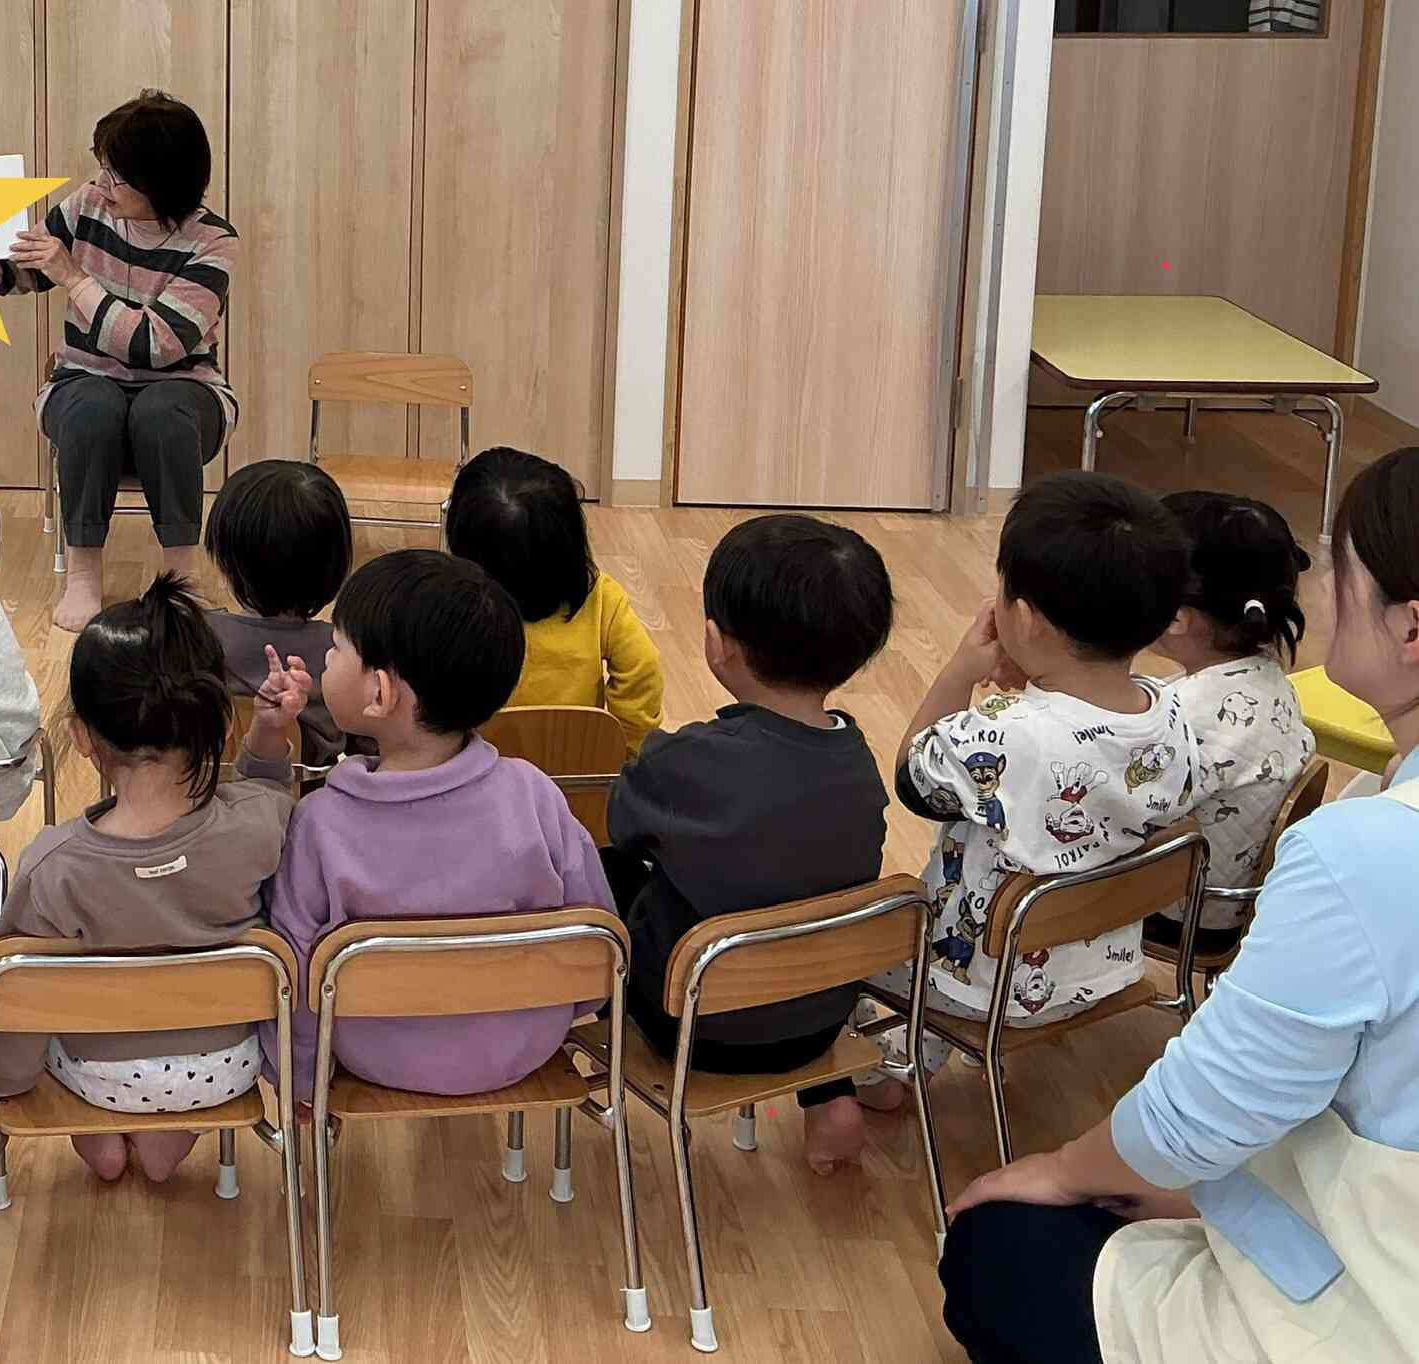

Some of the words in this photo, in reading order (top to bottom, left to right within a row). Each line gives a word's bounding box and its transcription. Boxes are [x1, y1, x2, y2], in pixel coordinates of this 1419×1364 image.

[1072, 725, 1115, 744] Smile!
[1054, 841, 1100, 869] PATROL
[1106, 945, 1135, 963] Smile!
